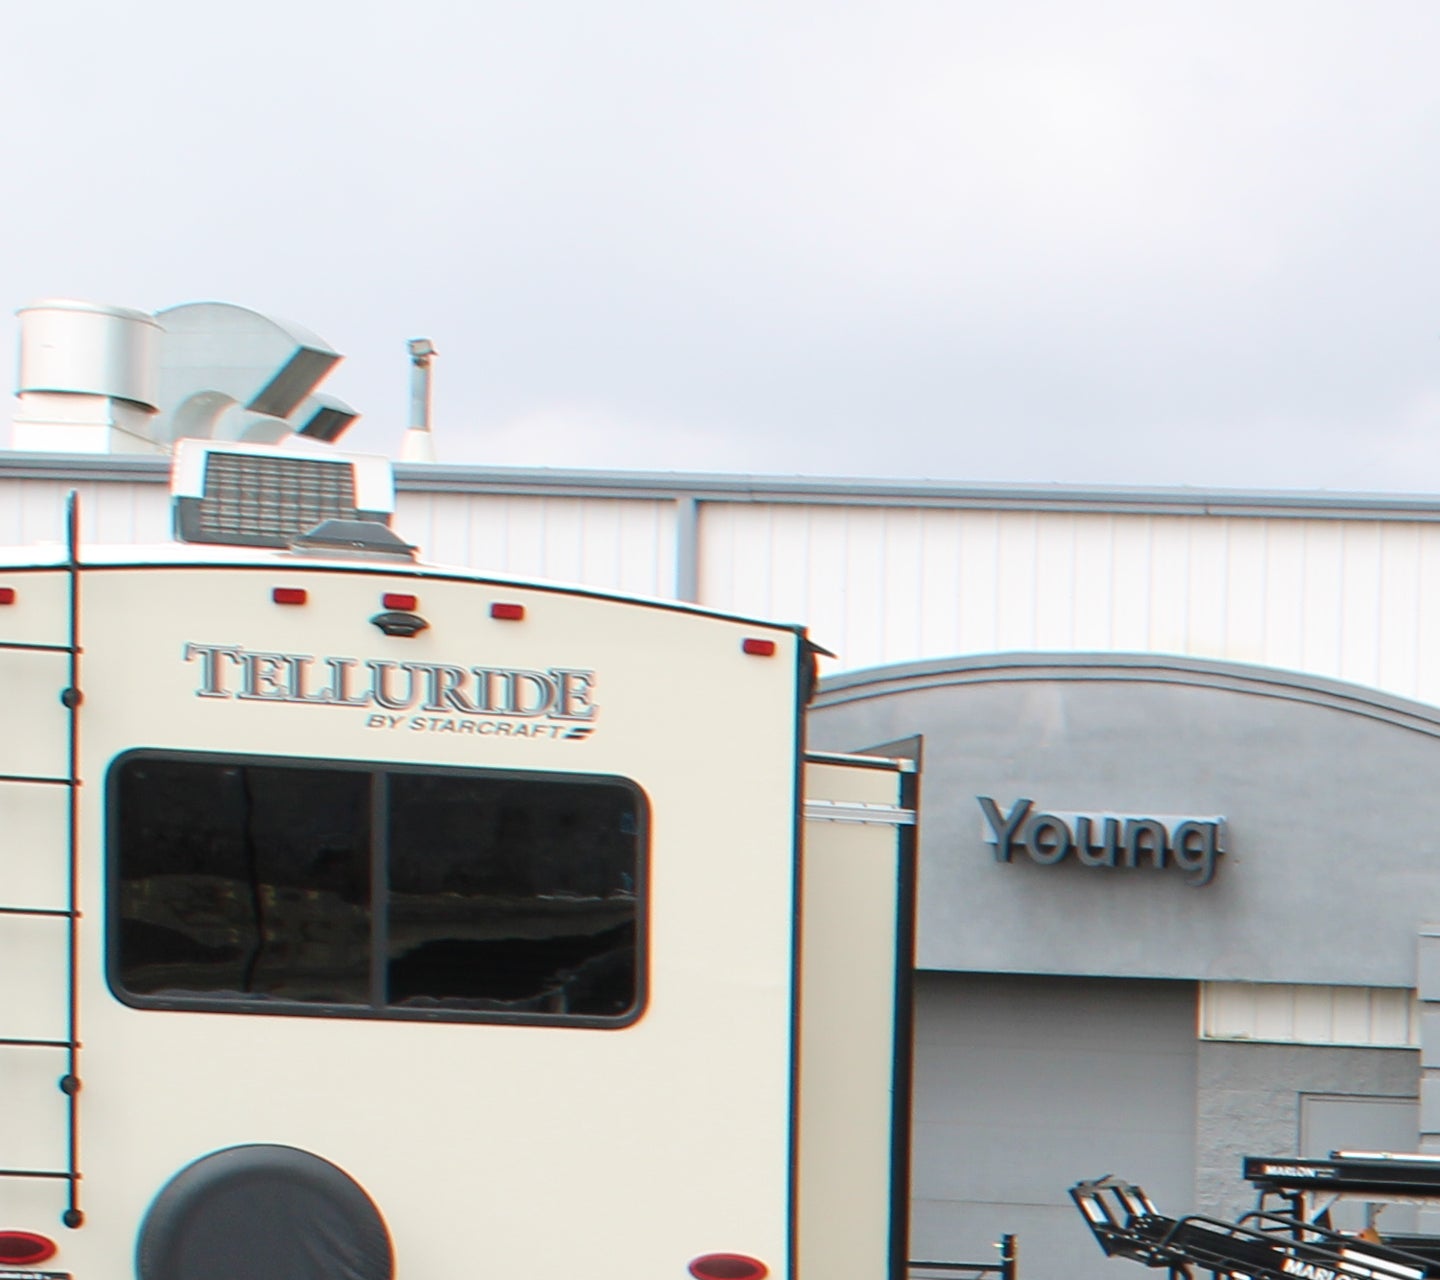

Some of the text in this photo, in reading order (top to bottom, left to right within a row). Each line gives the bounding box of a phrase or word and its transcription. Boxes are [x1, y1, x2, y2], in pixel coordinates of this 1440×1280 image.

[184, 642, 600, 722] TELLURIDE
[366, 714, 564, 740] BY STARCRAFT
[976, 796, 1218, 887] Young
